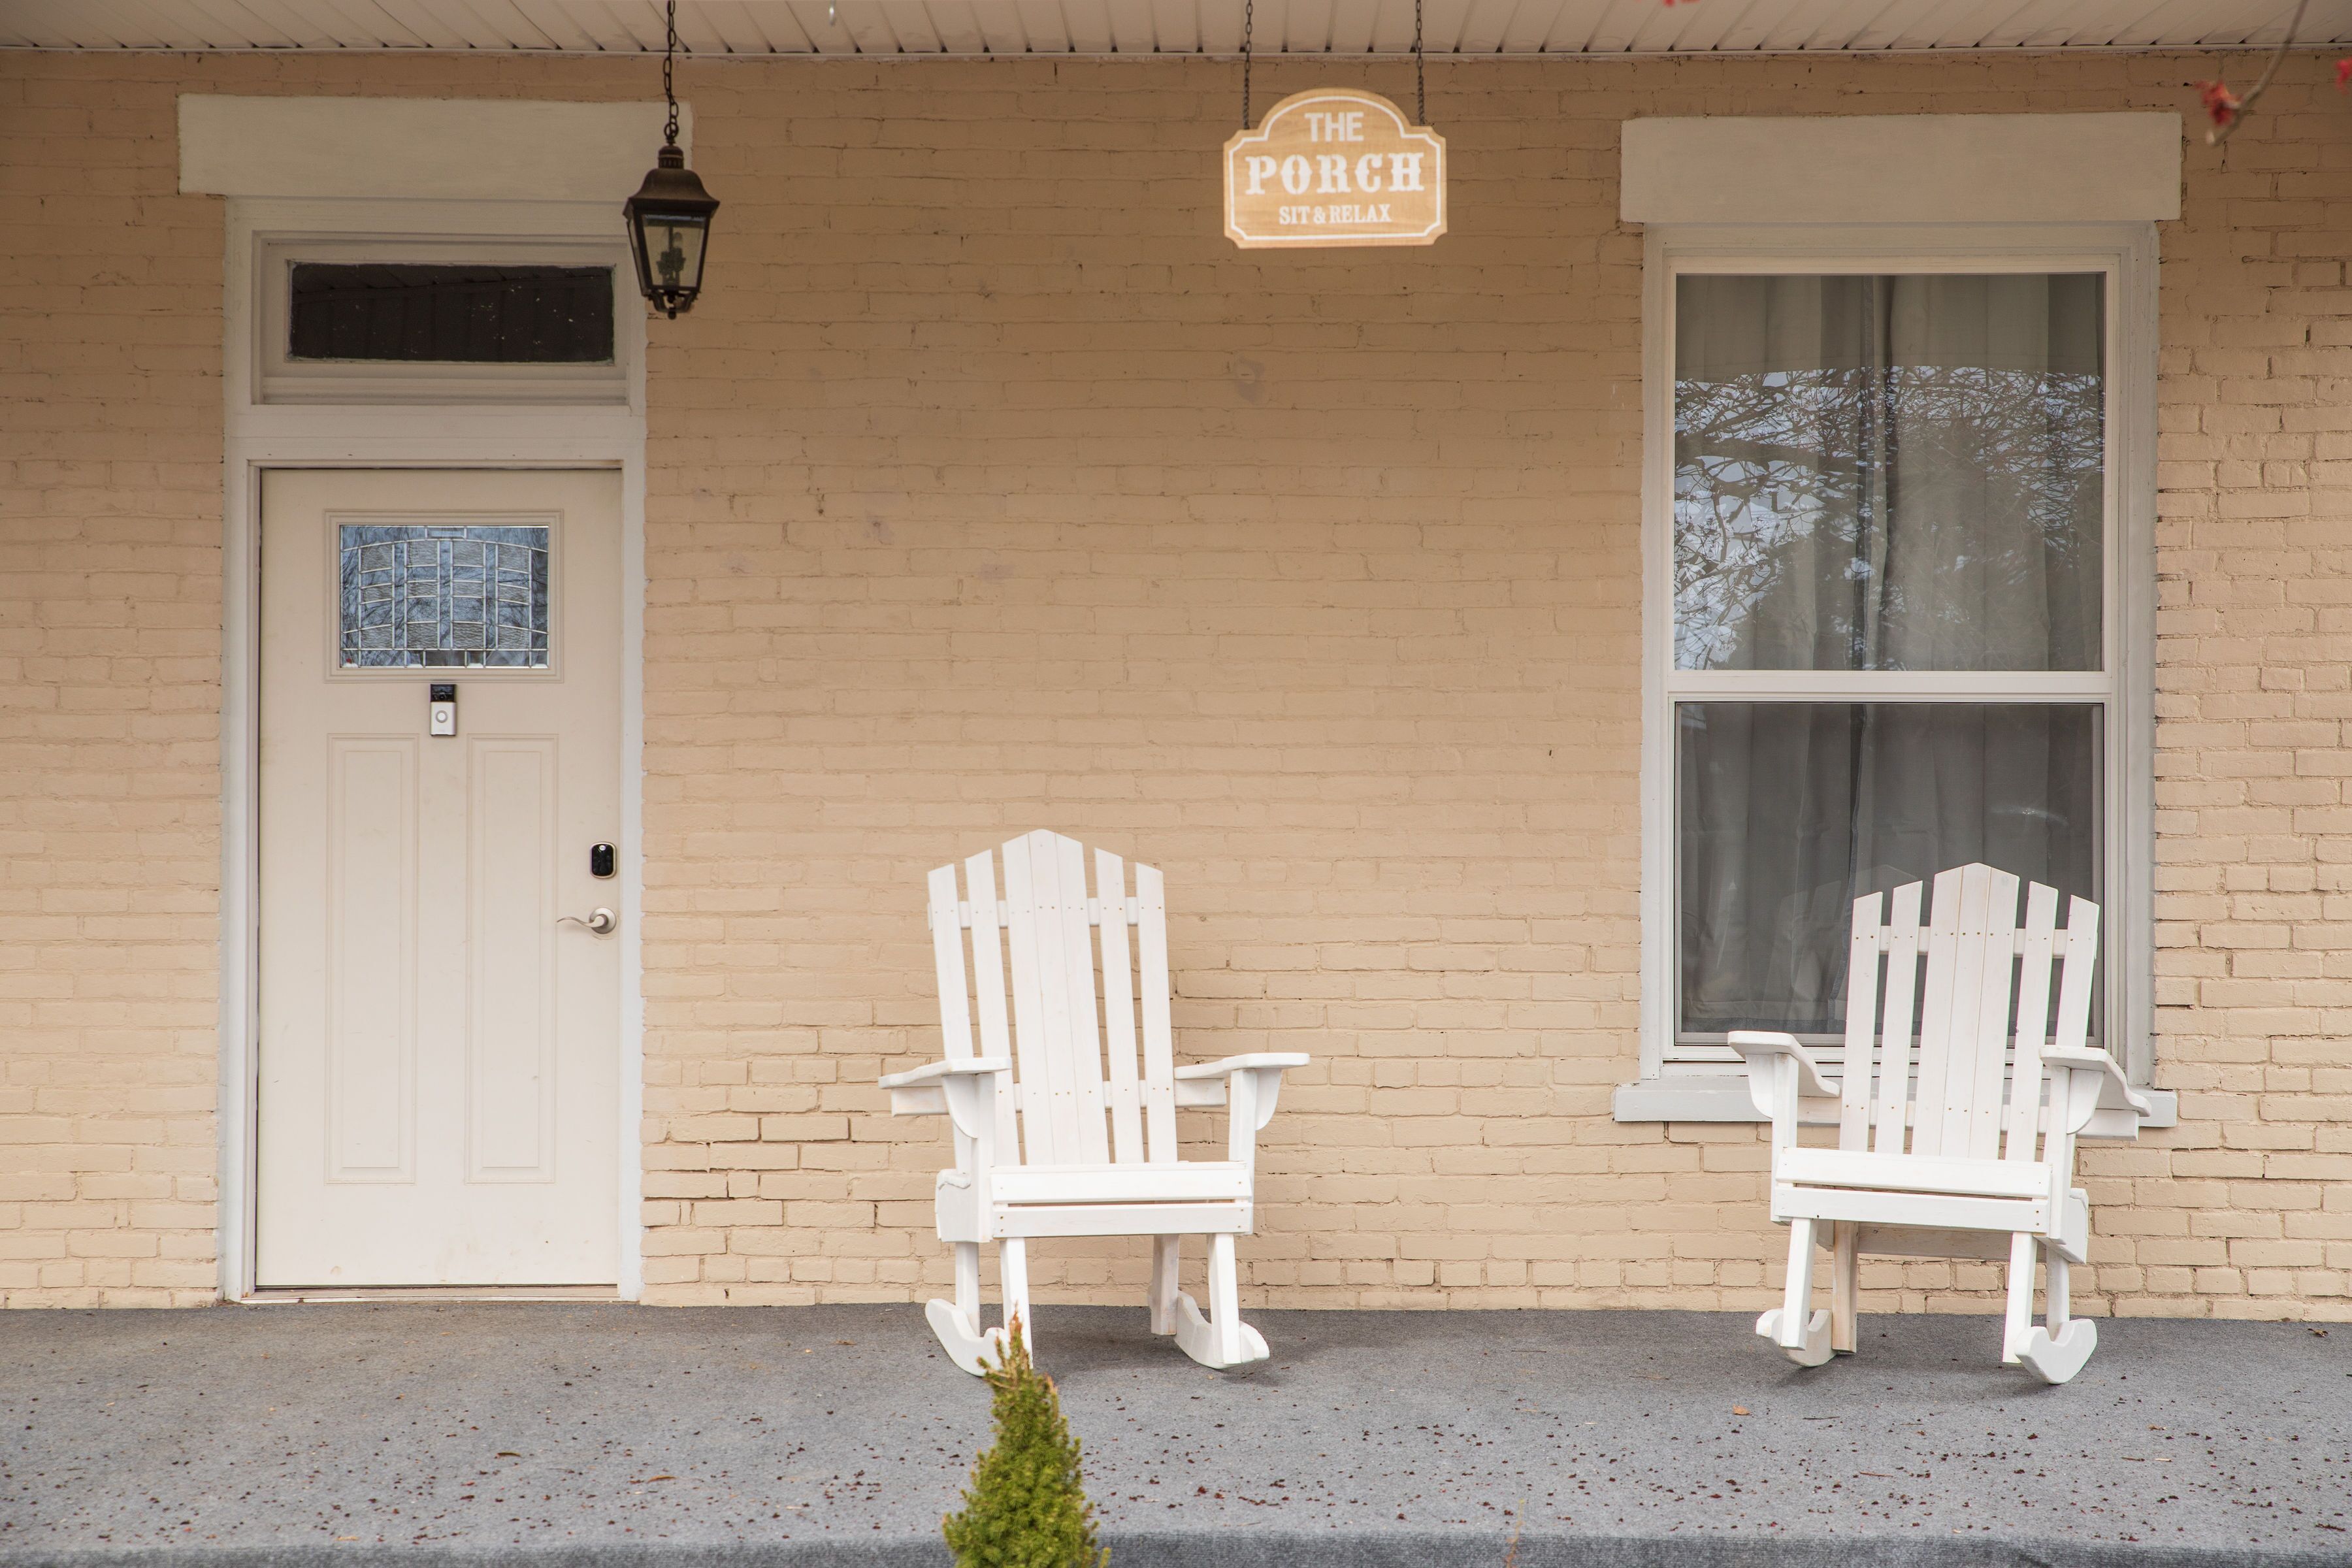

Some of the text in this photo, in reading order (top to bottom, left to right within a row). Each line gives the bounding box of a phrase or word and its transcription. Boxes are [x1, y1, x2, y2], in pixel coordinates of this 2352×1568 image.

[1305, 112, 1364, 142] THE
[1245, 152, 1424, 194] PORCH
[1279, 204, 1392, 225] SIT & RELAX
